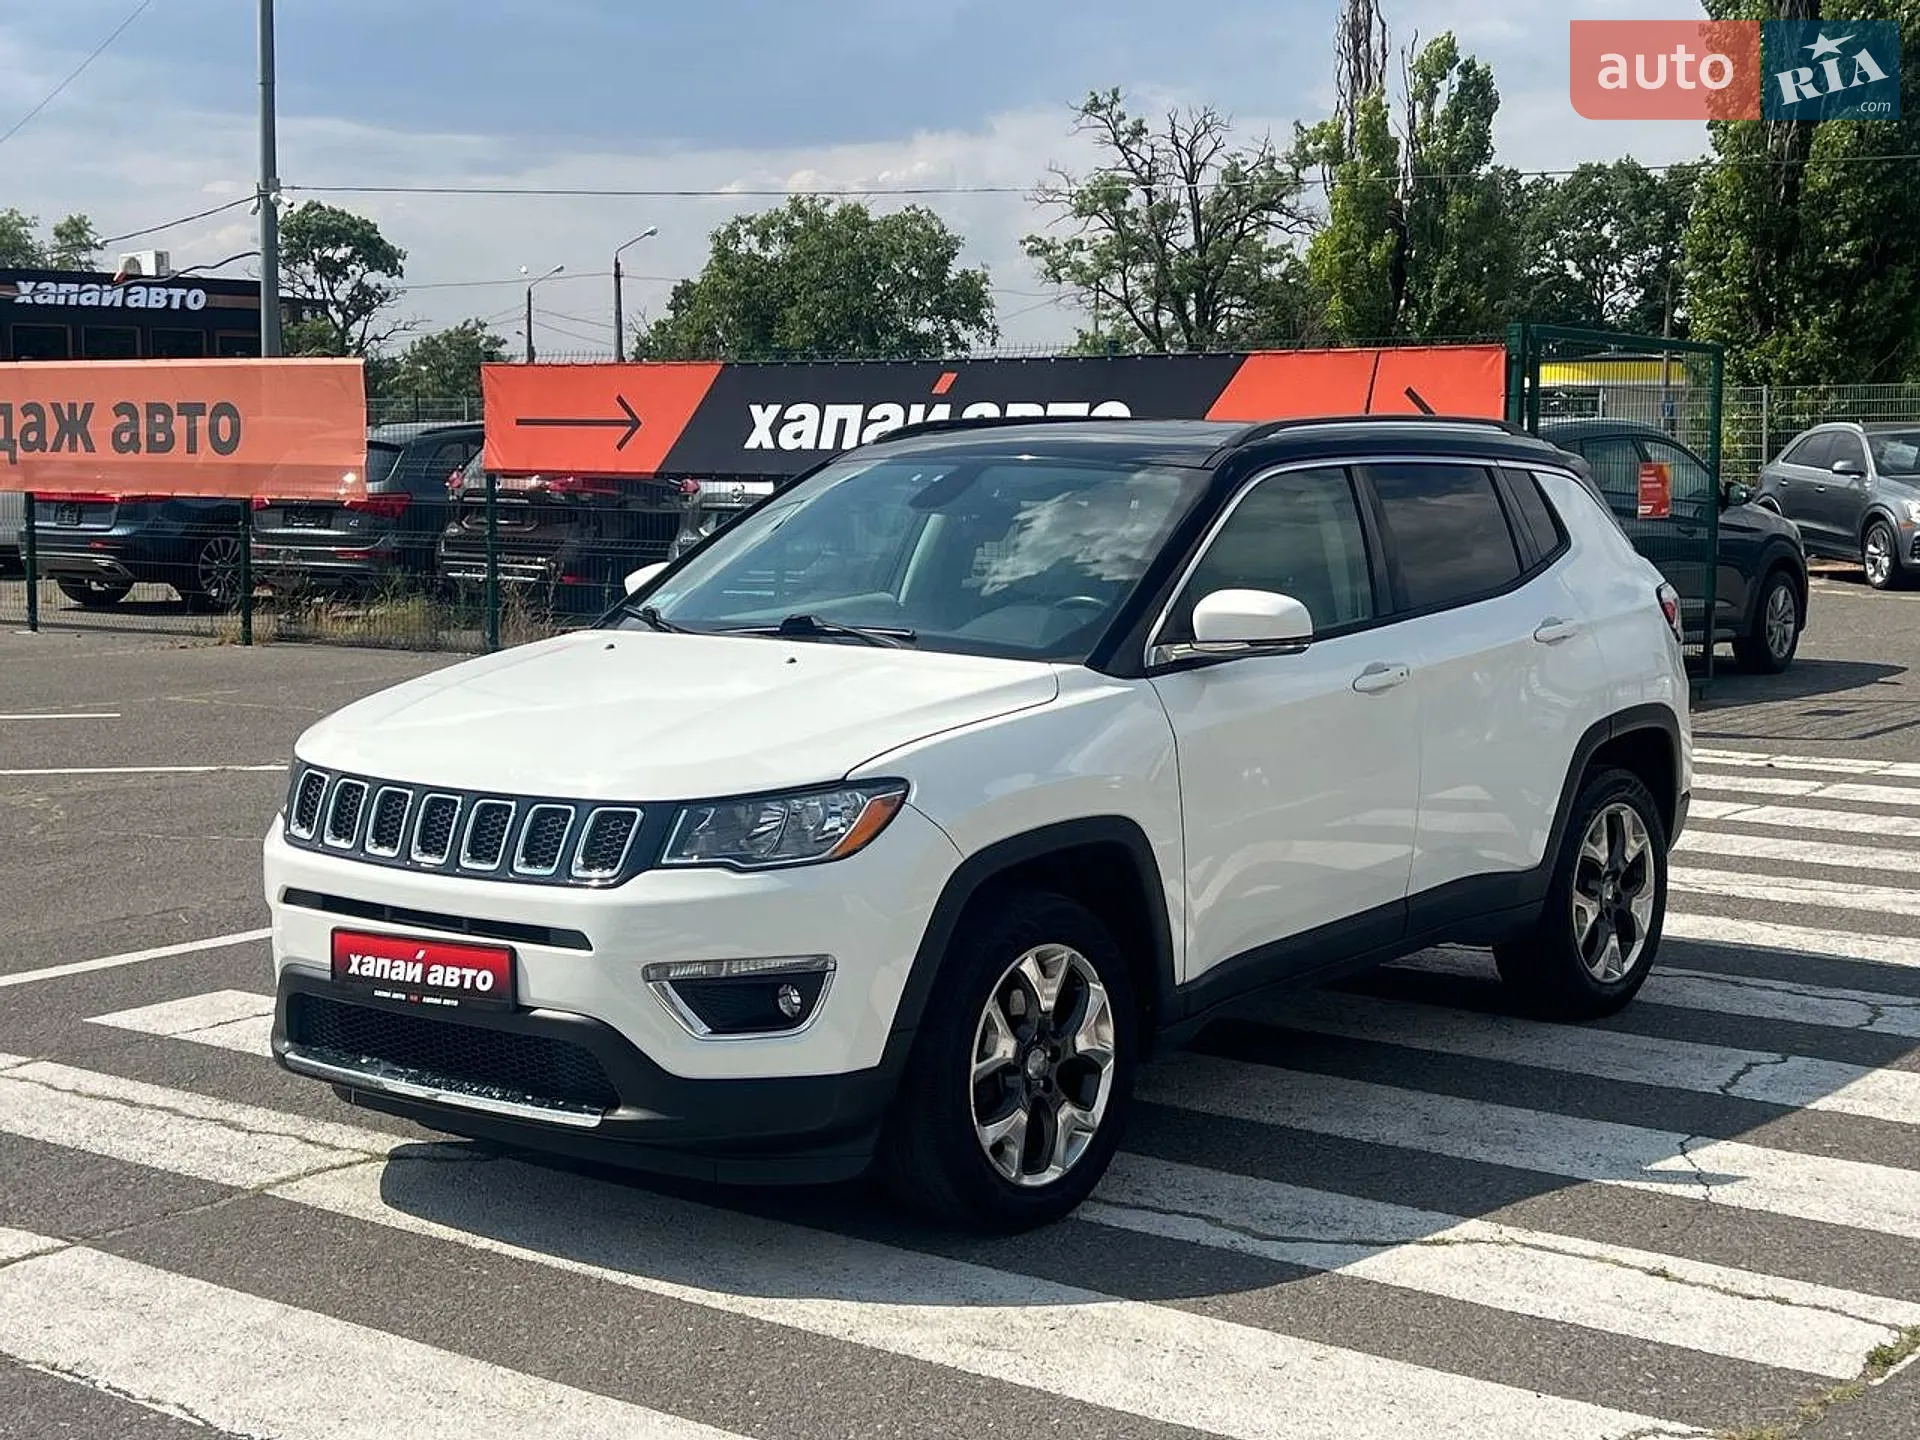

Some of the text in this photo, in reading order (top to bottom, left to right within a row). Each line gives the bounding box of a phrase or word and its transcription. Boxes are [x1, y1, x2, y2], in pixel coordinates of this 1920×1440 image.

[126, 286, 207, 311] авто
[111, 401, 241, 456] авто
[347, 950, 494, 992] хапай авто
